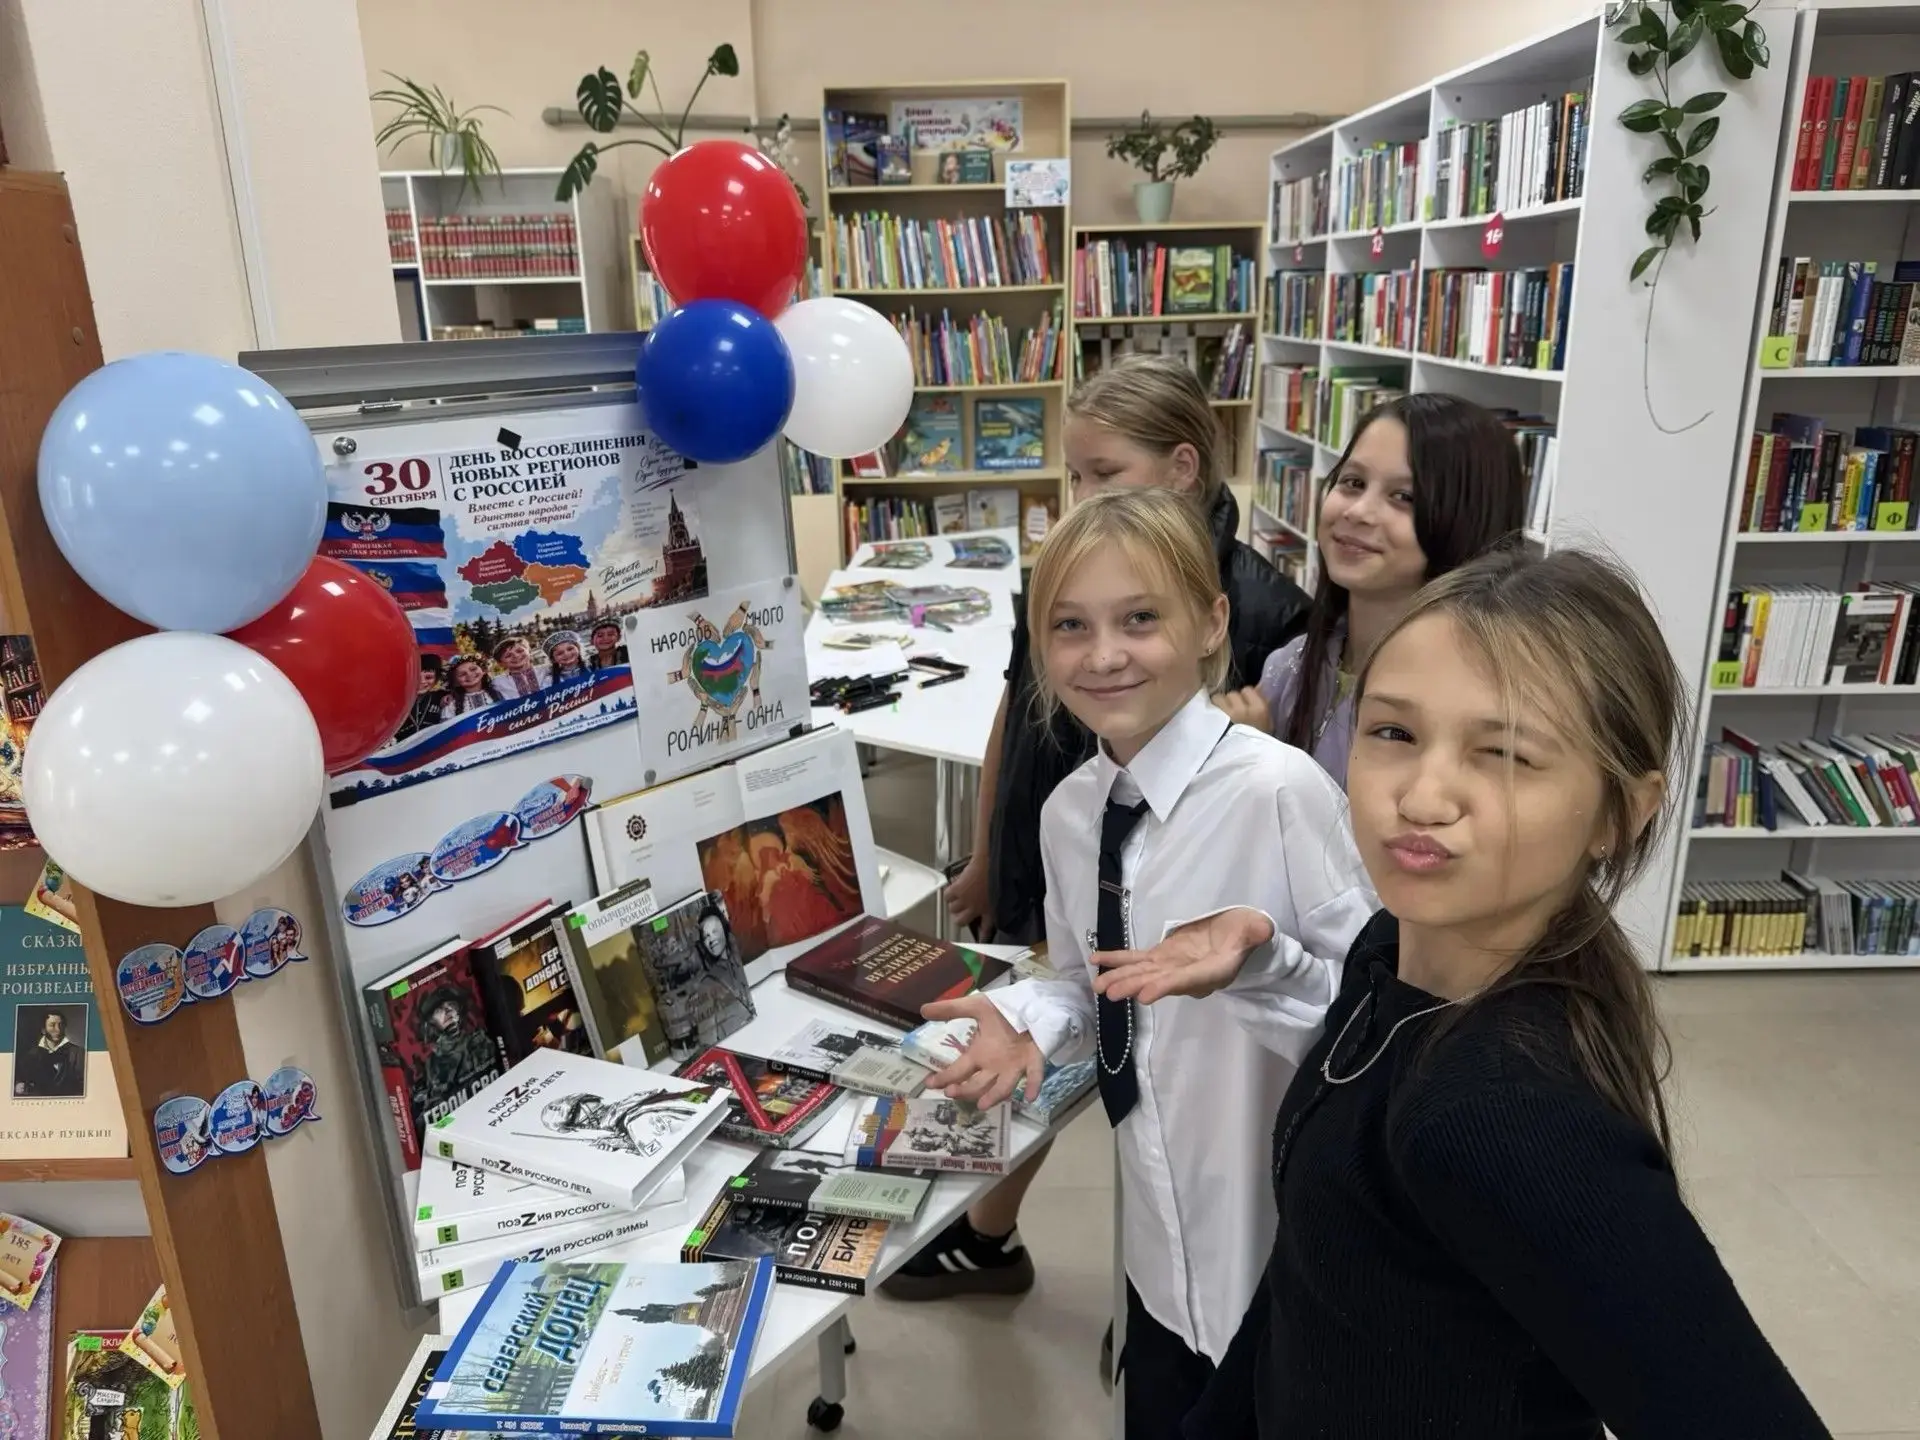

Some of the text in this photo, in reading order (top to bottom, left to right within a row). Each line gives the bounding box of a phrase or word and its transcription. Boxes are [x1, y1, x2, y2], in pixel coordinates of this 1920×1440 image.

[1775, 347, 1790, 361] С
[449, 451, 496, 470] ДЕНЬ
[500, 434, 646, 461] ВОССОЕДИНЕНИЯ
[364, 458, 431, 496] 30
[450, 452, 621, 485] НОВЫХ РЕГИОНОВ
[370, 490, 437, 507] СЕНТЯБРЯ
[453, 473, 567, 501] С РОССИЕЙ
[468, 499, 514, 514] Вместе
[529, 489, 583, 506] Россией!
[473, 504, 568, 525] Единство народов
[486, 511, 576, 532] сильная страна!
[1887, 512, 1903, 525] Ф
[651, 605, 784, 653] НАРОДОВ МНОГО
[477, 674, 596, 733] Единство народов
[508, 689, 594, 732] сила России!
[667, 700, 785, 756] РОДИНА ОДНА
[541, 946, 560, 966] ГЕР
[863, 937, 917, 969] ПАМЯТЬ
[865, 941, 933, 984] ВЕЛИКОЙ
[888, 947, 946, 984] ПОБЕДЫ
[7, 963, 91, 976] ИЗБРАННЫ
[525, 960, 564, 991] ДОНБАС
[2, 981, 94, 995] РОИЗВЕДЕН
[488, 1070, 566, 1128] РУССКОГО ЛЕТА
[0, 1129, 112, 1140] ЕКСАНДР ПУШКИН
[452, 1160, 472, 1189] ПОЭZ
[473, 1167, 485, 1197] РУССК
[481, 1157, 592, 1195] ПОЭZИЯ РУССКОГО ЛЕТА
[497, 1211, 552, 1230] ПОЭZИЯ
[787, 1212, 826, 1256] ПОЛ
[9, 1233, 31, 1251] 185
[509, 1219, 649, 1263] ОЭZИЯ РУССКОЙ ЗИМЫ
[832, 1218, 868, 1263] БИТВ
[533, 1277, 611, 1365] ДОНЕЦ
[480, 1291, 550, 1394] СЕВЕРСКИЙ
